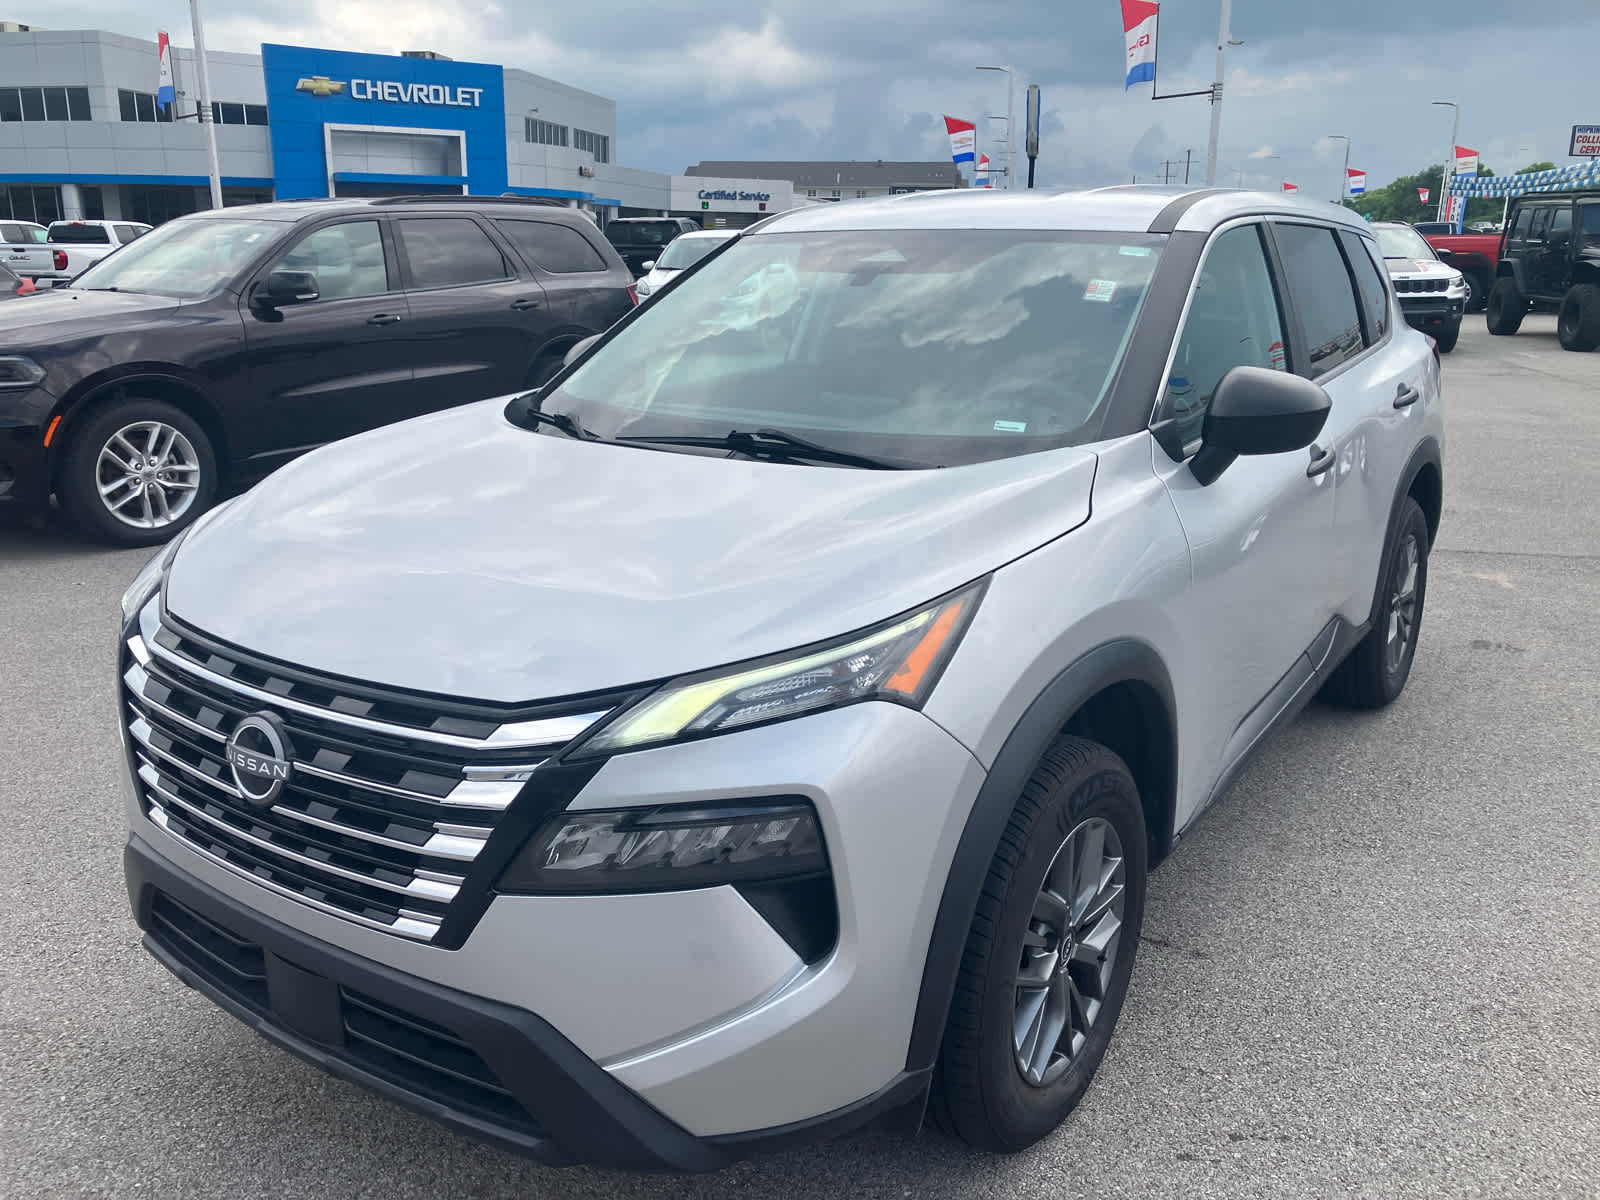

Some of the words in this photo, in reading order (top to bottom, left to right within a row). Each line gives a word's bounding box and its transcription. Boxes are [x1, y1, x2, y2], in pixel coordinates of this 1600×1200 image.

[351, 79, 483, 107] CHEVROLET
[698, 189, 737, 200] Certified
[738, 191, 770, 202] Service
[227, 748, 287, 778] NISSAN
